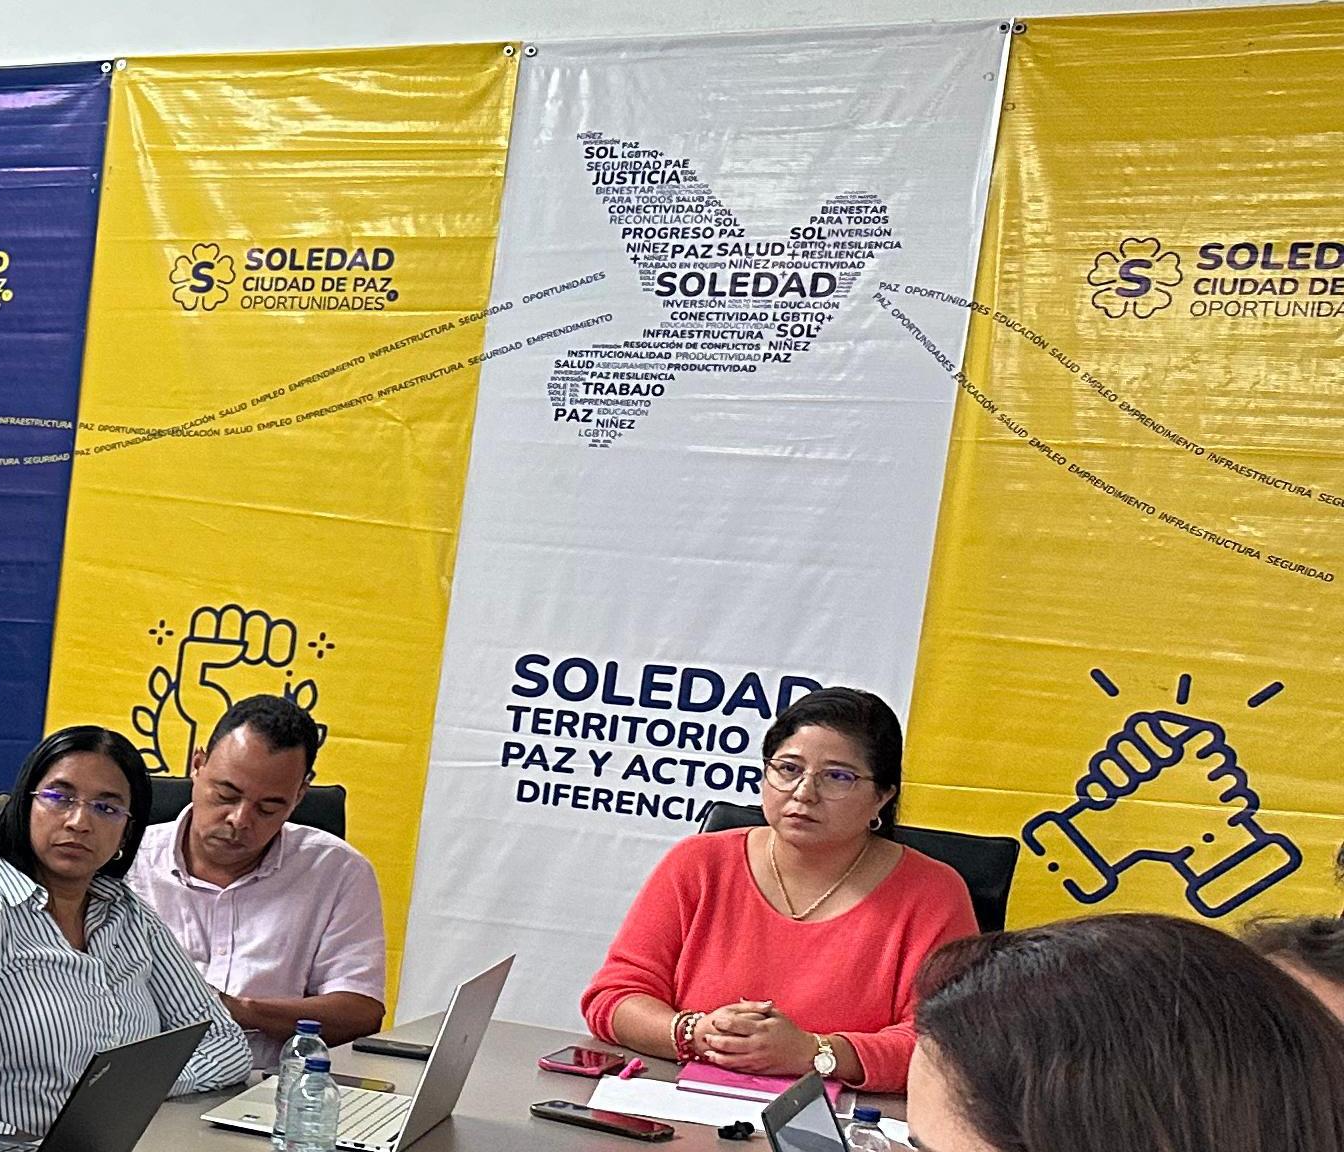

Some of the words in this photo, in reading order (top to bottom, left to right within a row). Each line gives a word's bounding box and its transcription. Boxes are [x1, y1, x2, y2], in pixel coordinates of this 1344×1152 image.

[584, 146, 619, 159] SOL
[586, 160, 661, 171] SEGURIDAD
[592, 170, 681, 185] JUSTICIA
[595, 186, 655, 195] BIENESTAR
[602, 196, 632, 204] PARA
[636, 196, 673, 204] TODOS
[608, 204, 704, 214] CONECTIVIDAD
[714, 209, 733, 217] SOL
[821, 205, 887, 215] BIENESTAR
[714, 217, 740, 227] SOL
[810, 216, 842, 224] PARA
[846, 215, 889, 224] TODOS
[622, 227, 715, 239] PROGRESO
[719, 228, 745, 238] PAZ
[790, 226, 826, 240] SOL
[827, 226, 892, 238] INVERSIÓN
[626, 240, 669, 254] NIÑEZ
[670, 244, 714, 259] PAZ
[716, 242, 785, 257] SALUD
[833, 241, 902, 249] RESILIENCIA
[244, 247, 395, 271] SOLEDAD
[801, 250, 875, 259] RESILIENCIA
[728, 256, 770, 270] NIÑEZ
[771, 261, 865, 269] PRODUCTIVIDAD
[242, 276, 315, 293] CIUDAD
[321, 277, 348, 292] DE
[353, 277, 392, 293] PAZ
[522, 271, 606, 304] OPORTUNIDADES
[655, 271, 837, 298] SOLEDAD
[1193, 277, 1299, 296] CIUDAD
[240, 295, 385, 311] OPORTUNIDADES
[662, 297, 726, 309] INVERSIÓN
[773, 300, 840, 310] EDUCACIÓN
[670, 311, 769, 321] CONECTIVIDAD
[772, 312, 834, 325] LGBTIQ+
[526, 313, 613, 346] EMPRENDIMIENTO
[642, 329, 764, 340] INFRAESTRUCTURA
[776, 323, 817, 338] SOL
[623, 340, 683, 349] RESOLUCIÓN
[700, 342, 761, 350] CONFLICTOS
[768, 338, 811, 351] NIÑEZ
[218, 402, 248, 418] SALUD
[250, 388, 286, 407] EMPLEO
[288, 355, 366, 392] EMPRENDIMIENTO
[368, 321, 456, 360] INFRAESTRUCTURA
[458, 301, 514, 326] SEGURIDAD
[567, 350, 672, 360] INSTITUCIONALIDAD
[675, 351, 761, 361] PRODUCTIVIDAD
[762, 352, 792, 363] PAZ
[554, 360, 595, 369] SALUD
[667, 363, 757, 373] PRODUCTIVIDAD
[590, 371, 611, 380] PAZ
[612, 371, 676, 381] RESILIENCIA
[78, 422, 95, 431] PAZ
[223, 424, 253, 436] SALUD
[256, 416, 293, 432] EMPLEO
[295, 393, 374, 423] EMPRENDIMIENTO
[377, 362, 464, 399] INFRAESTRUCTURA
[467, 341, 523, 366] SEGURIDAD
[582, 382, 665, 397] TRABAJO
[878, 281, 900, 293] PAZ
[904, 285, 991, 316] OPORTUNIDADES
[992, 311, 1050, 350] EDUCACIÓN
[1048, 347, 1081, 373] SALUD
[1080, 372, 1119, 403] EMPLEO
[1118, 400, 1205, 456] EMPRENDIMIENTO
[1206, 452, 1313, 499] INFRAESTRUCTURA
[569, 399, 651, 407] EMPRENDIMIENTO
[553, 408, 593, 423] PAZ
[597, 408, 649, 416] EDUCACIÓN
[595, 416, 636, 429] NIÑEZ
[872, 292, 892, 310] PAZ
[891, 308, 956, 373] OPORTUNIDADES
[997, 413, 1029, 439] SALUD
[1028, 437, 1067, 466] EMPLEO
[1067, 463, 1156, 515] EMPRENDIMIENTO
[1158, 511, 1261, 560] INFRAESTRUCTURA
[1265, 555, 1335, 583] SEGURIDAD
[23, 452, 70, 465] SEGURIDAD
[511, 654, 824, 720] SOLEDAD
[506, 704, 750, 755] TERRITORIO
[500, 741, 577, 775] PAZ
[589, 749, 613, 778] Y
